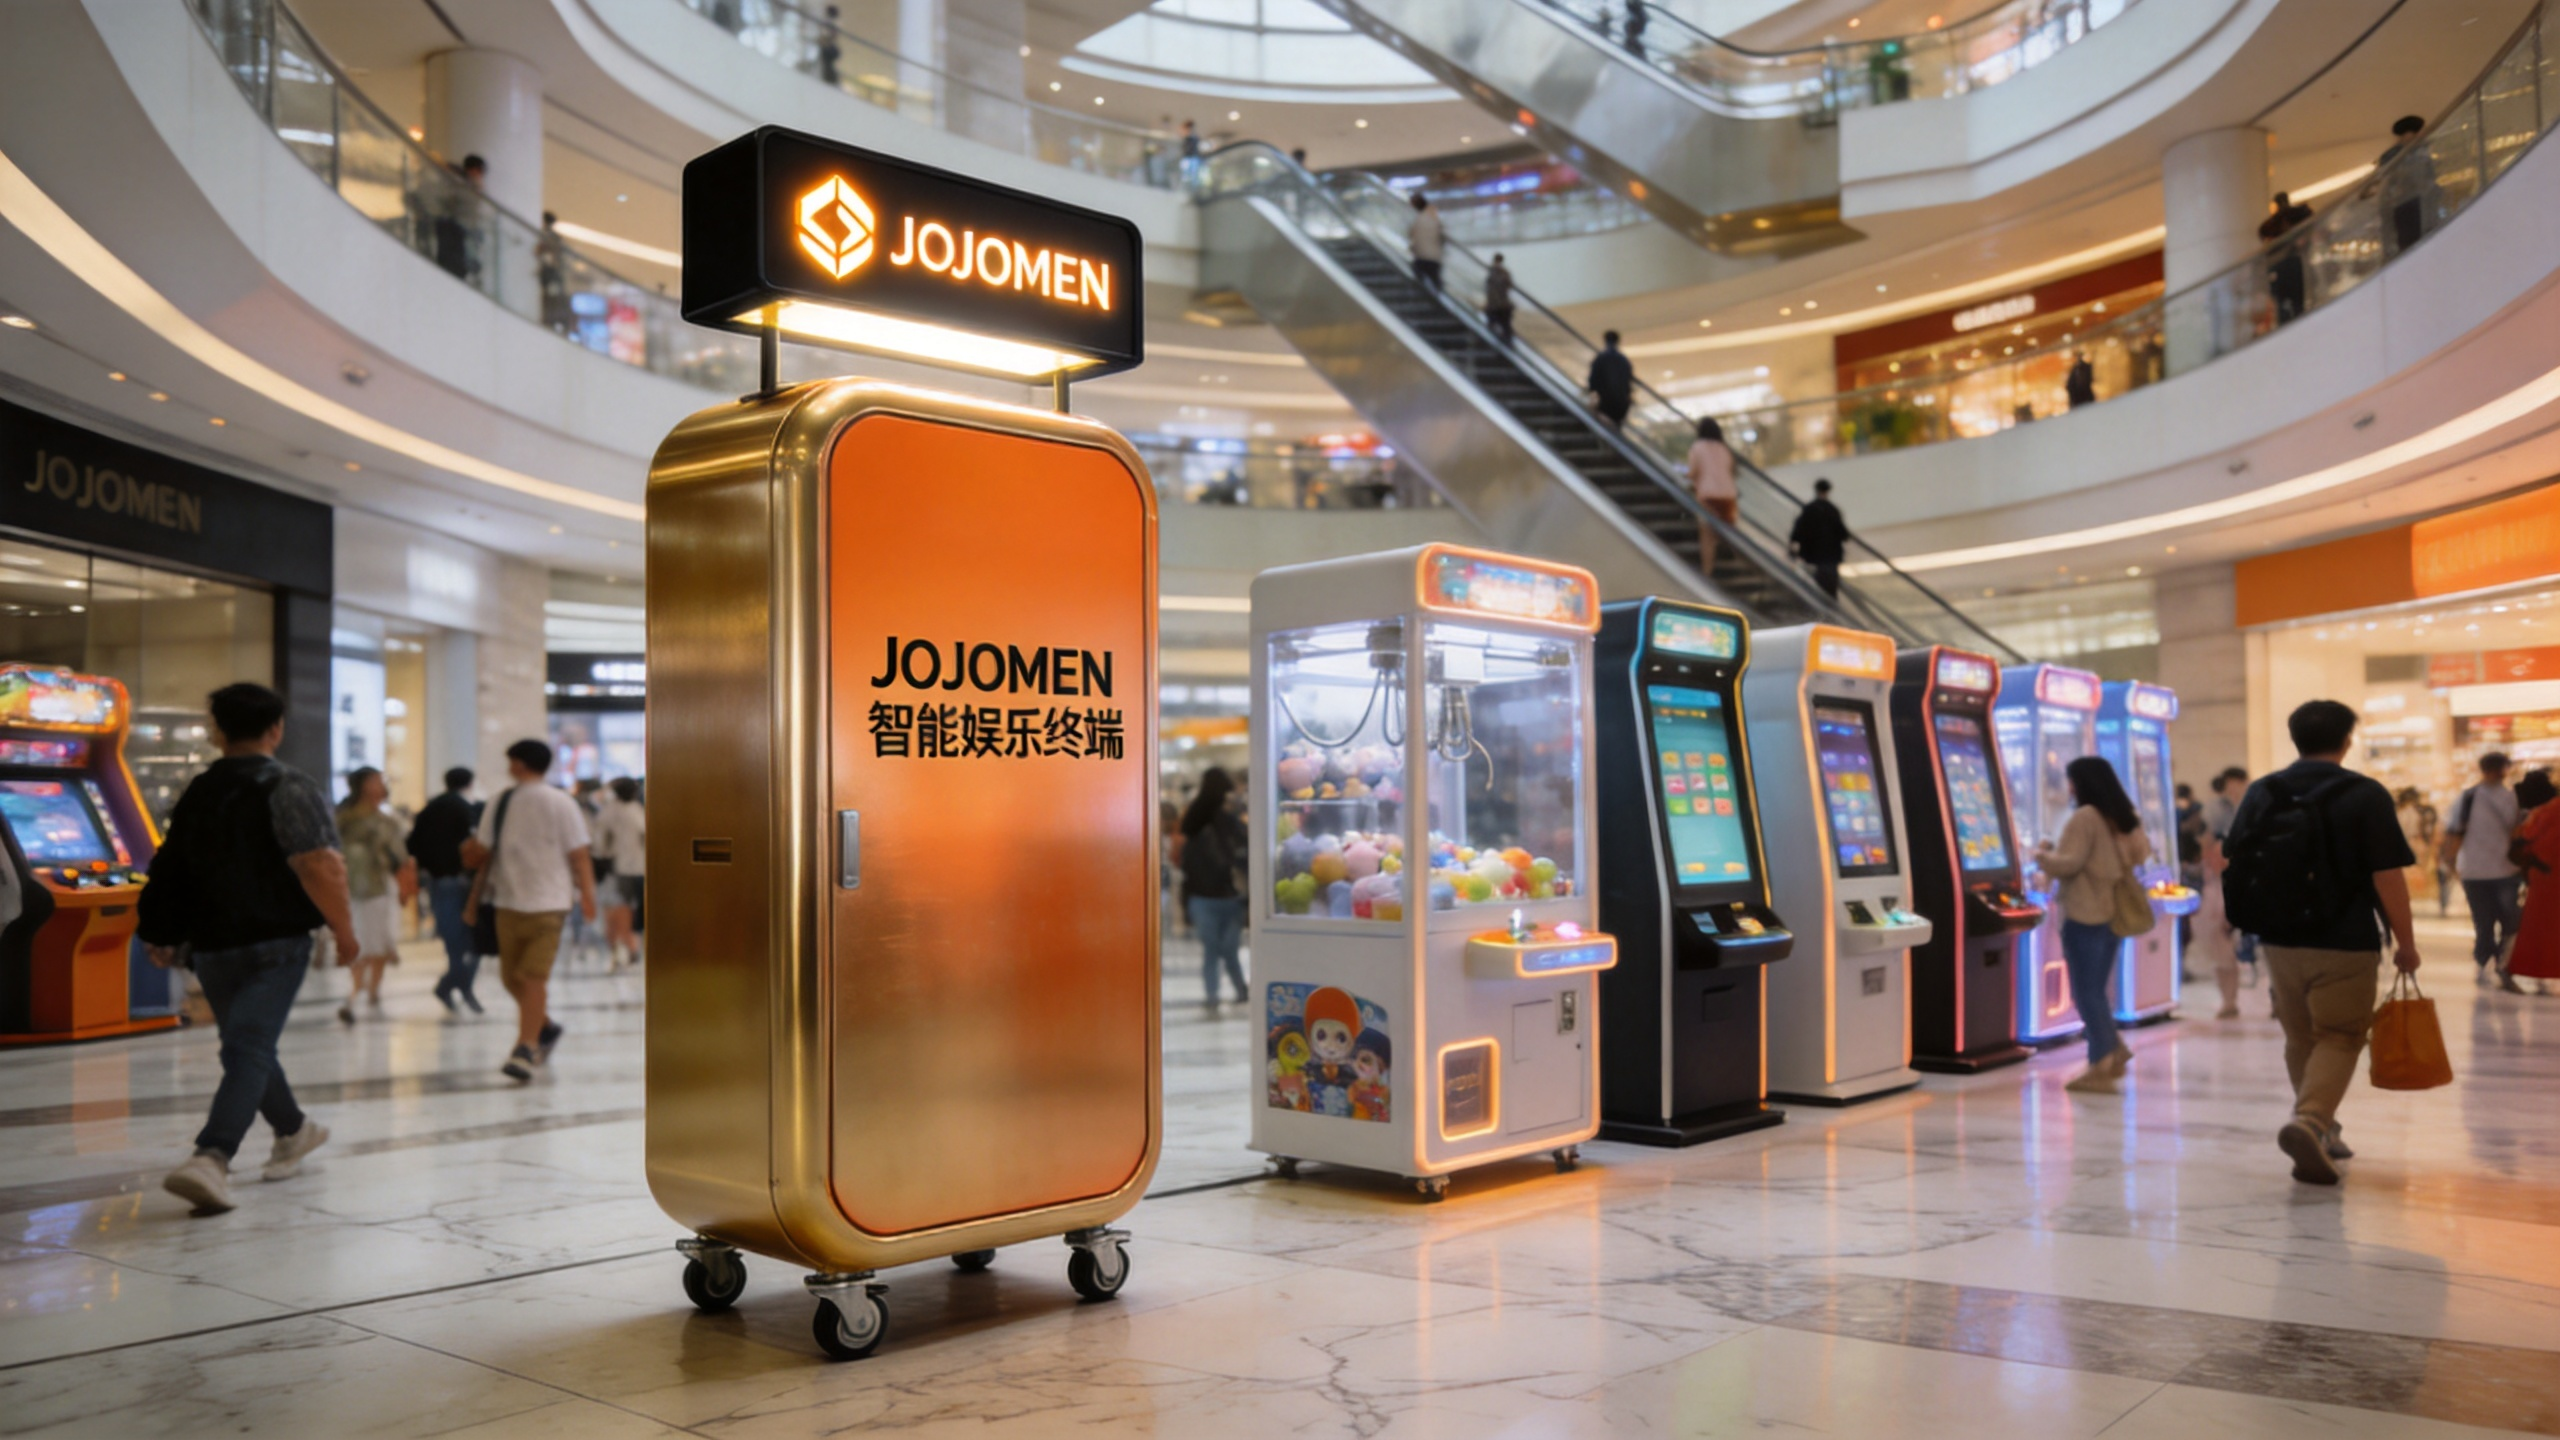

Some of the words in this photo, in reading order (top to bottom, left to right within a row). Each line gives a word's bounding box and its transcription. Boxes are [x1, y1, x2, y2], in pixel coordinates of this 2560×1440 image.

[889, 216, 1111, 310] JOJOMEN
[25, 449, 203, 533] JOJOMEN
[870, 636, 1113, 697] JOJOMEN
[868, 700, 1125, 760] 智能娱乐终端
